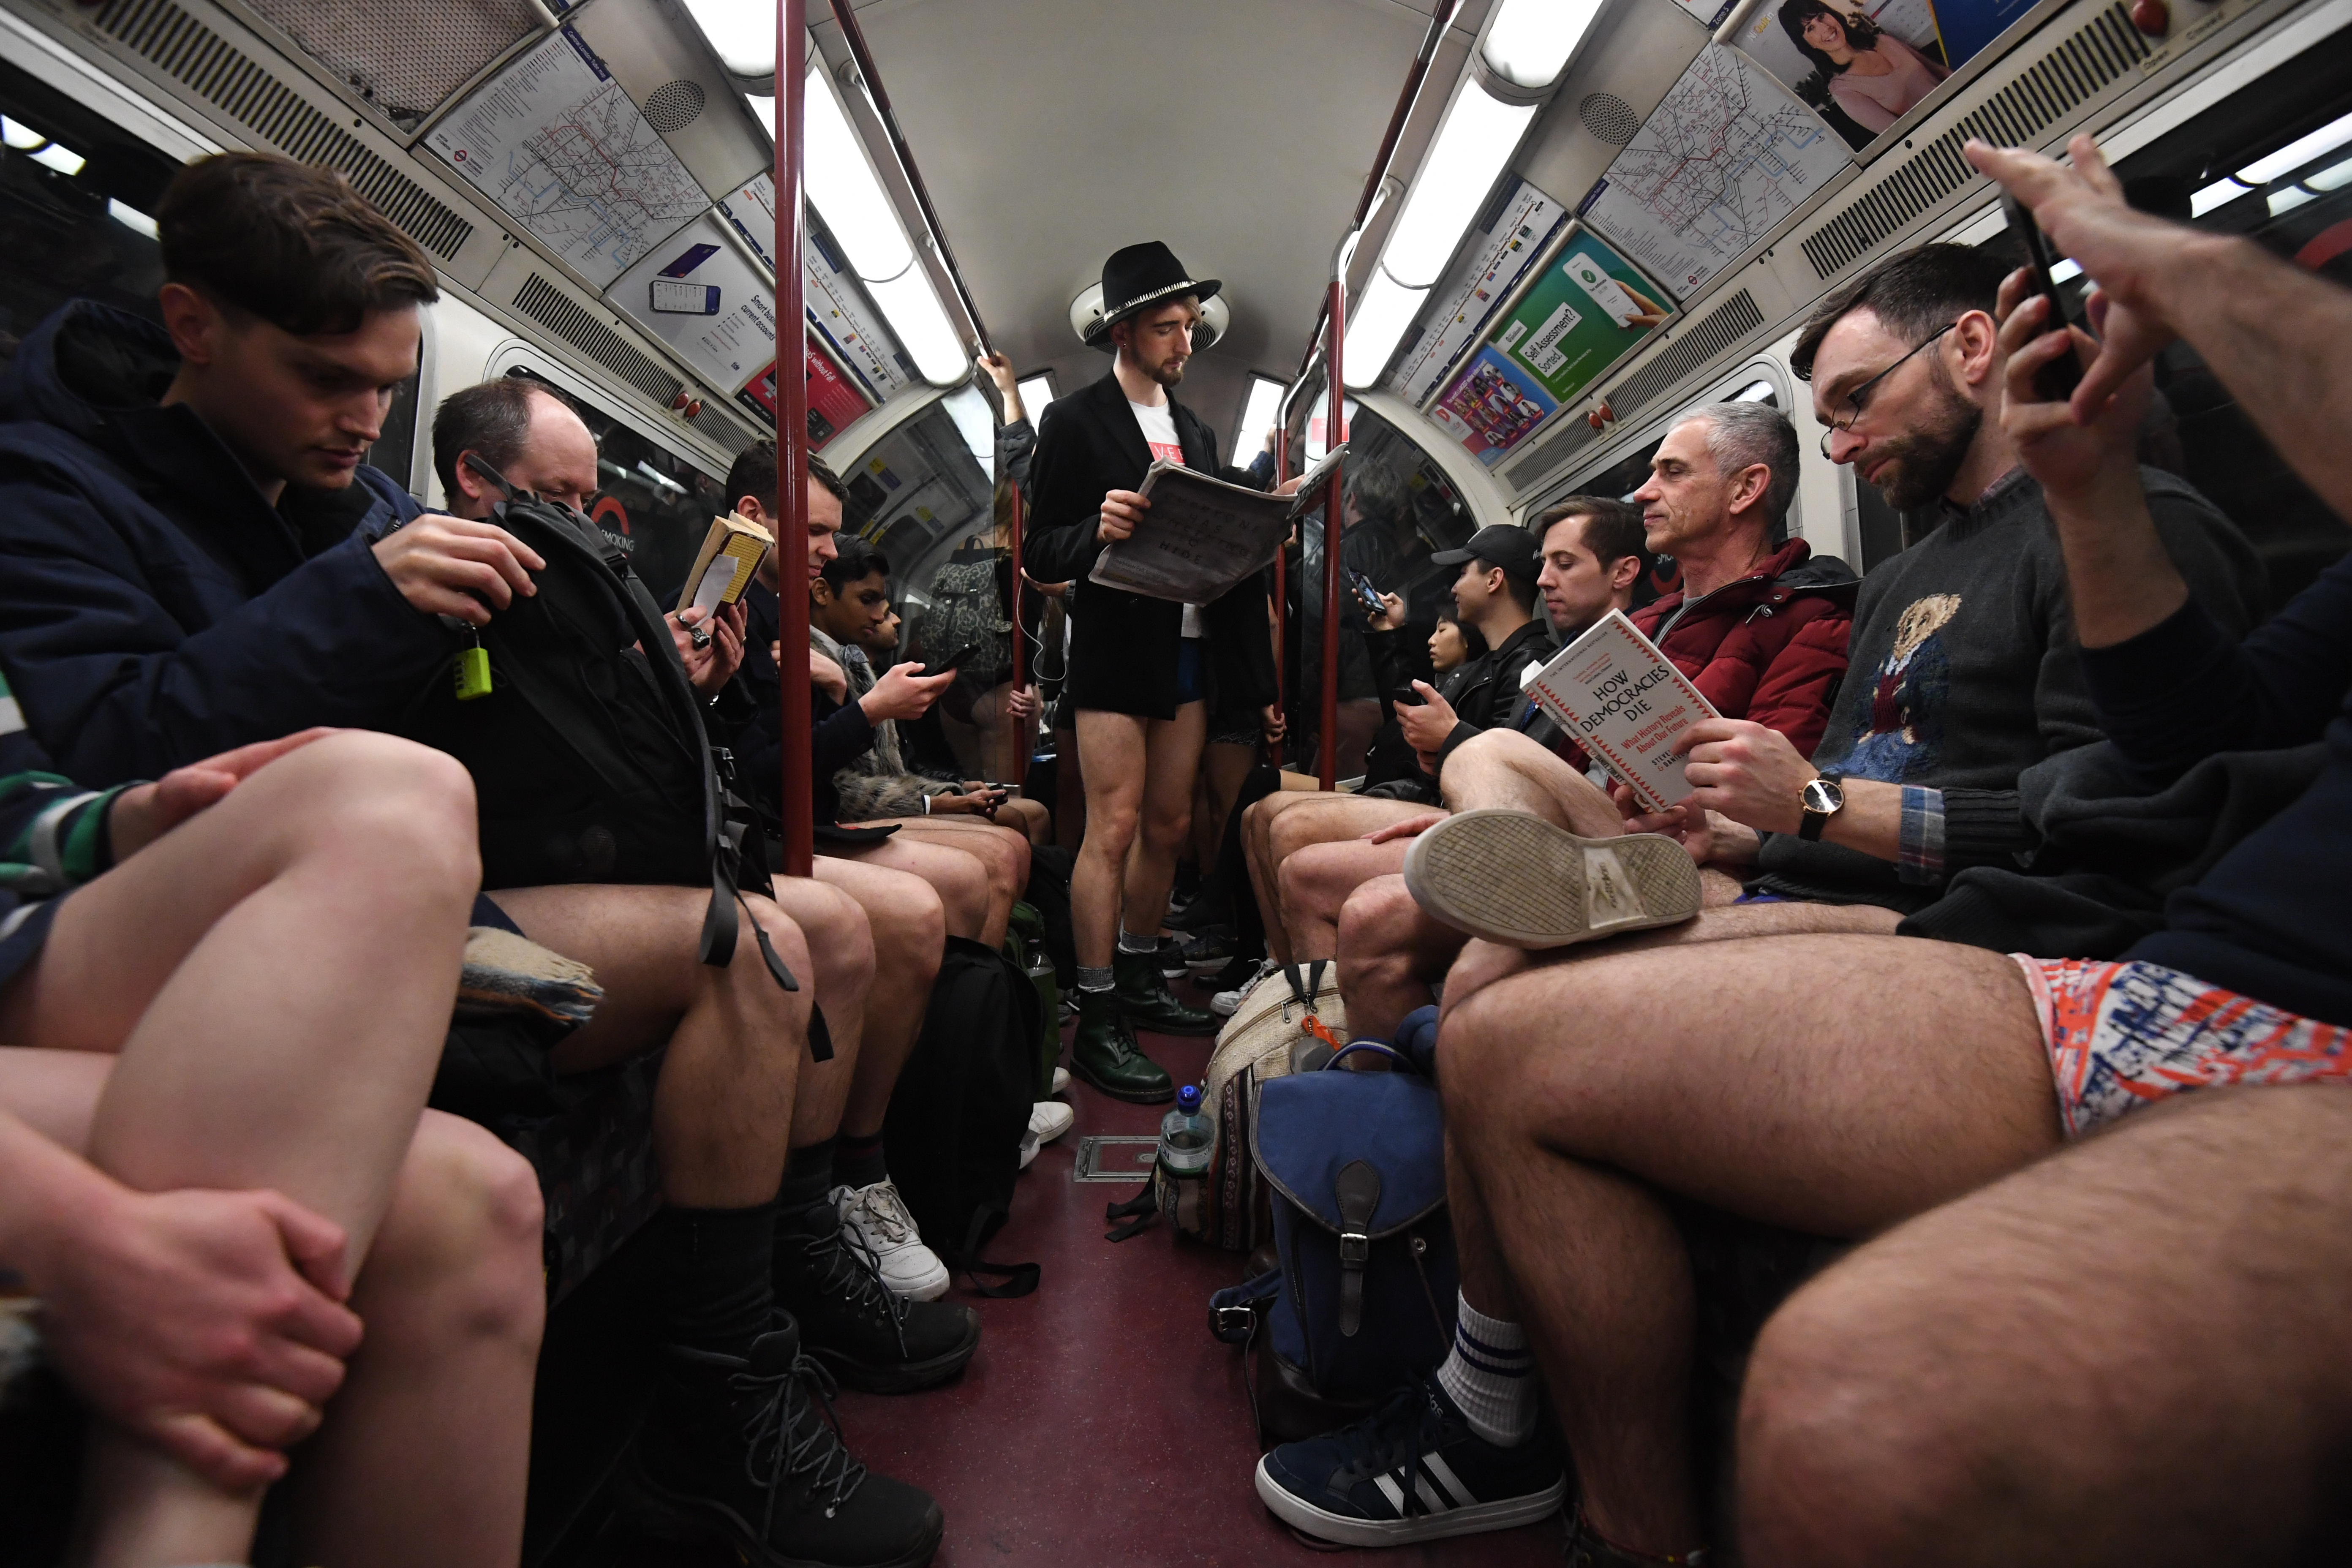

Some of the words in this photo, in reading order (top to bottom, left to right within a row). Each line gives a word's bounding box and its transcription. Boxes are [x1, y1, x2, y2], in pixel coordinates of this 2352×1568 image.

[1712, 9, 1726, 25] Zone
[566, 29, 583, 47] Central
[578, 44, 594, 61] London
[589, 58, 601, 70] Tube
[595, 68, 607, 79] map
[750, 294, 769, 313] Smart
[740, 302, 760, 324] current
[754, 318, 777, 342] accounts
[1523, 345, 1542, 362] Self
[1534, 307, 1577, 352] Assessment?
[730, 361, 741, 372] tide
[810, 355, 830, 376] without
[823, 371, 836, 383] Faff
[1537, 348, 1563, 373] Sorted.
[1159, 540, 1203, 564] HIDE
[1580, 665, 1670, 733] DEMOCRACIES
[1592, 670, 1629, 702] HOW
[1624, 700, 1652, 722] DIE
[1621, 730, 1639, 750] What
[1636, 715, 1663, 740] History
[1660, 705, 1686, 725] Reveals
[1636, 740, 1655, 754] About
[1652, 731, 1668, 746] Our
[1666, 718, 1688, 738] Future
[1651, 749, 1672, 766] STEVE
